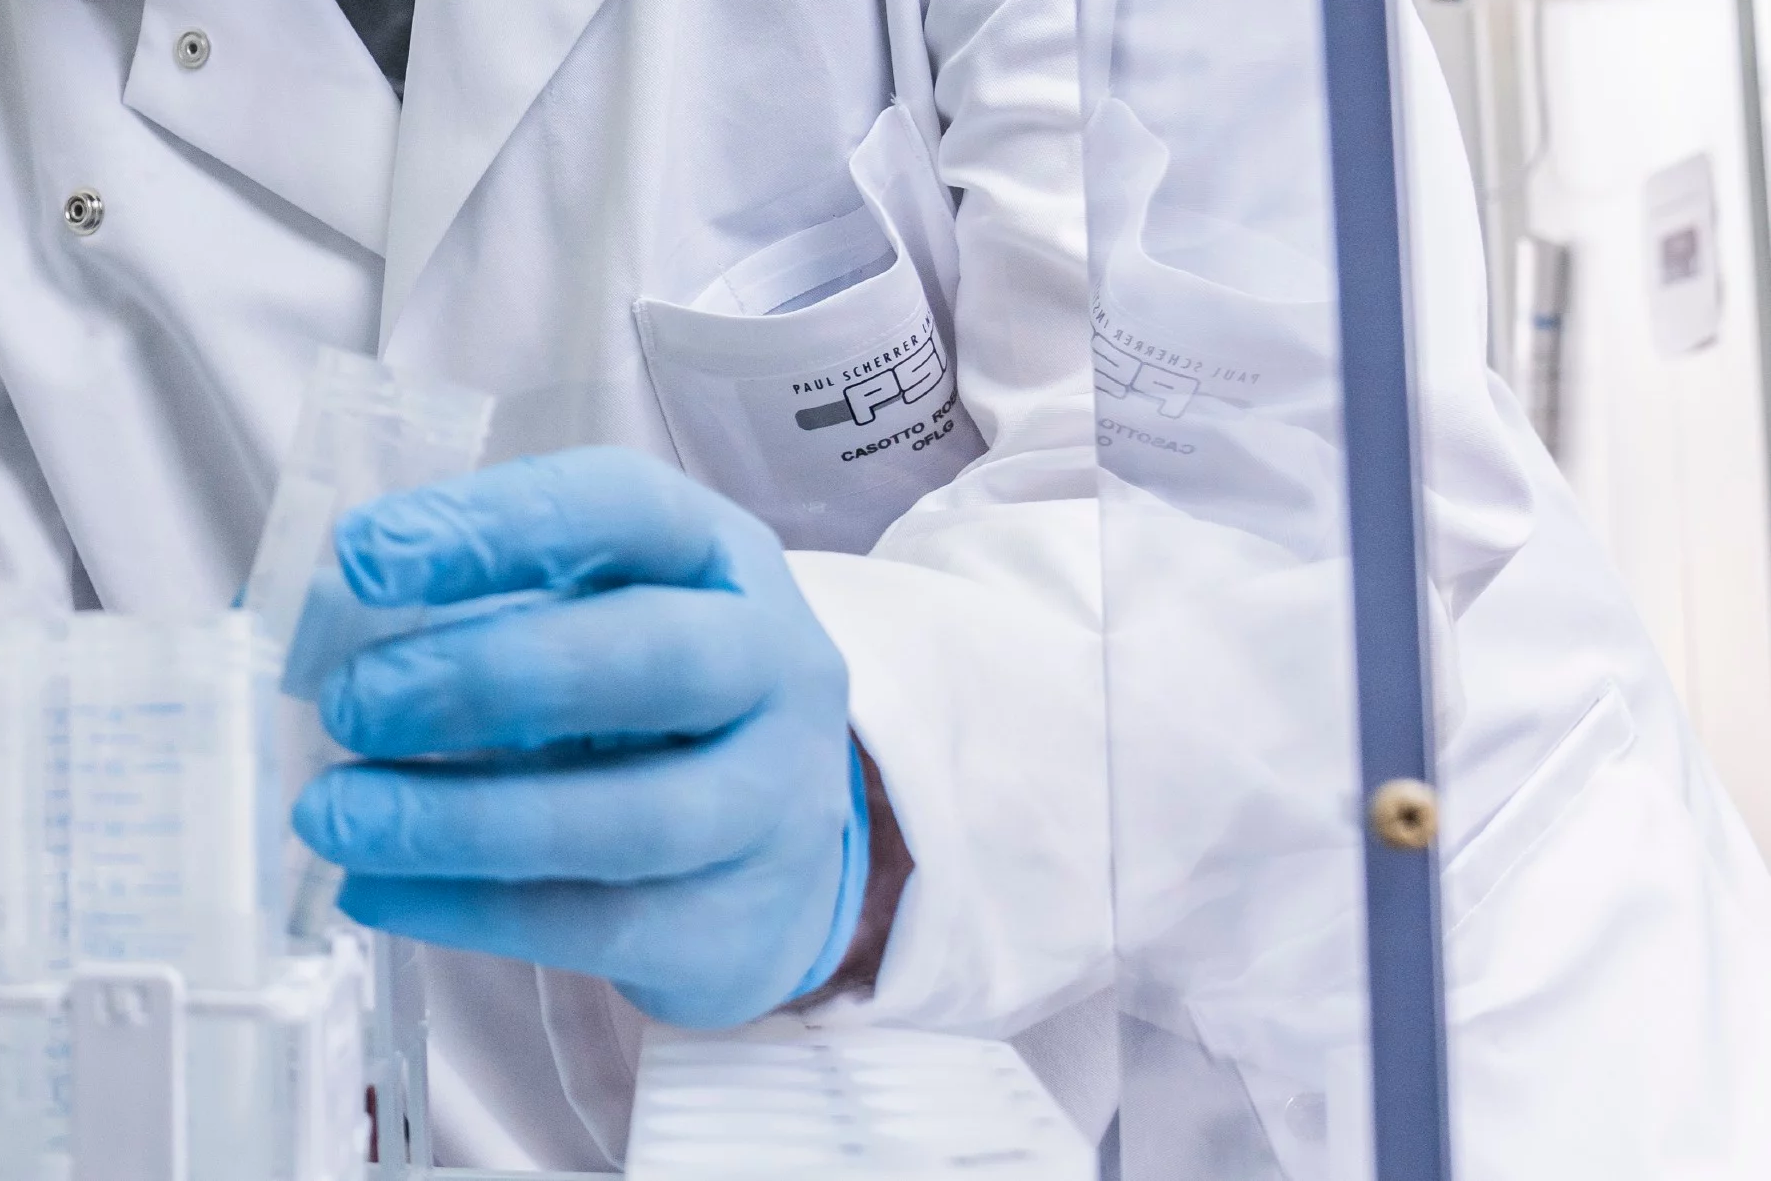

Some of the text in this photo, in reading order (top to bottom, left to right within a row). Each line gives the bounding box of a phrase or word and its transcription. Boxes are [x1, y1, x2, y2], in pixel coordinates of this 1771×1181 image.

[792, 376, 835, 395] PAUL
[842, 333, 919, 382] SCHERRER
[840, 421, 925, 462] CASOTTO
[911, 419, 955, 452] OFLG
